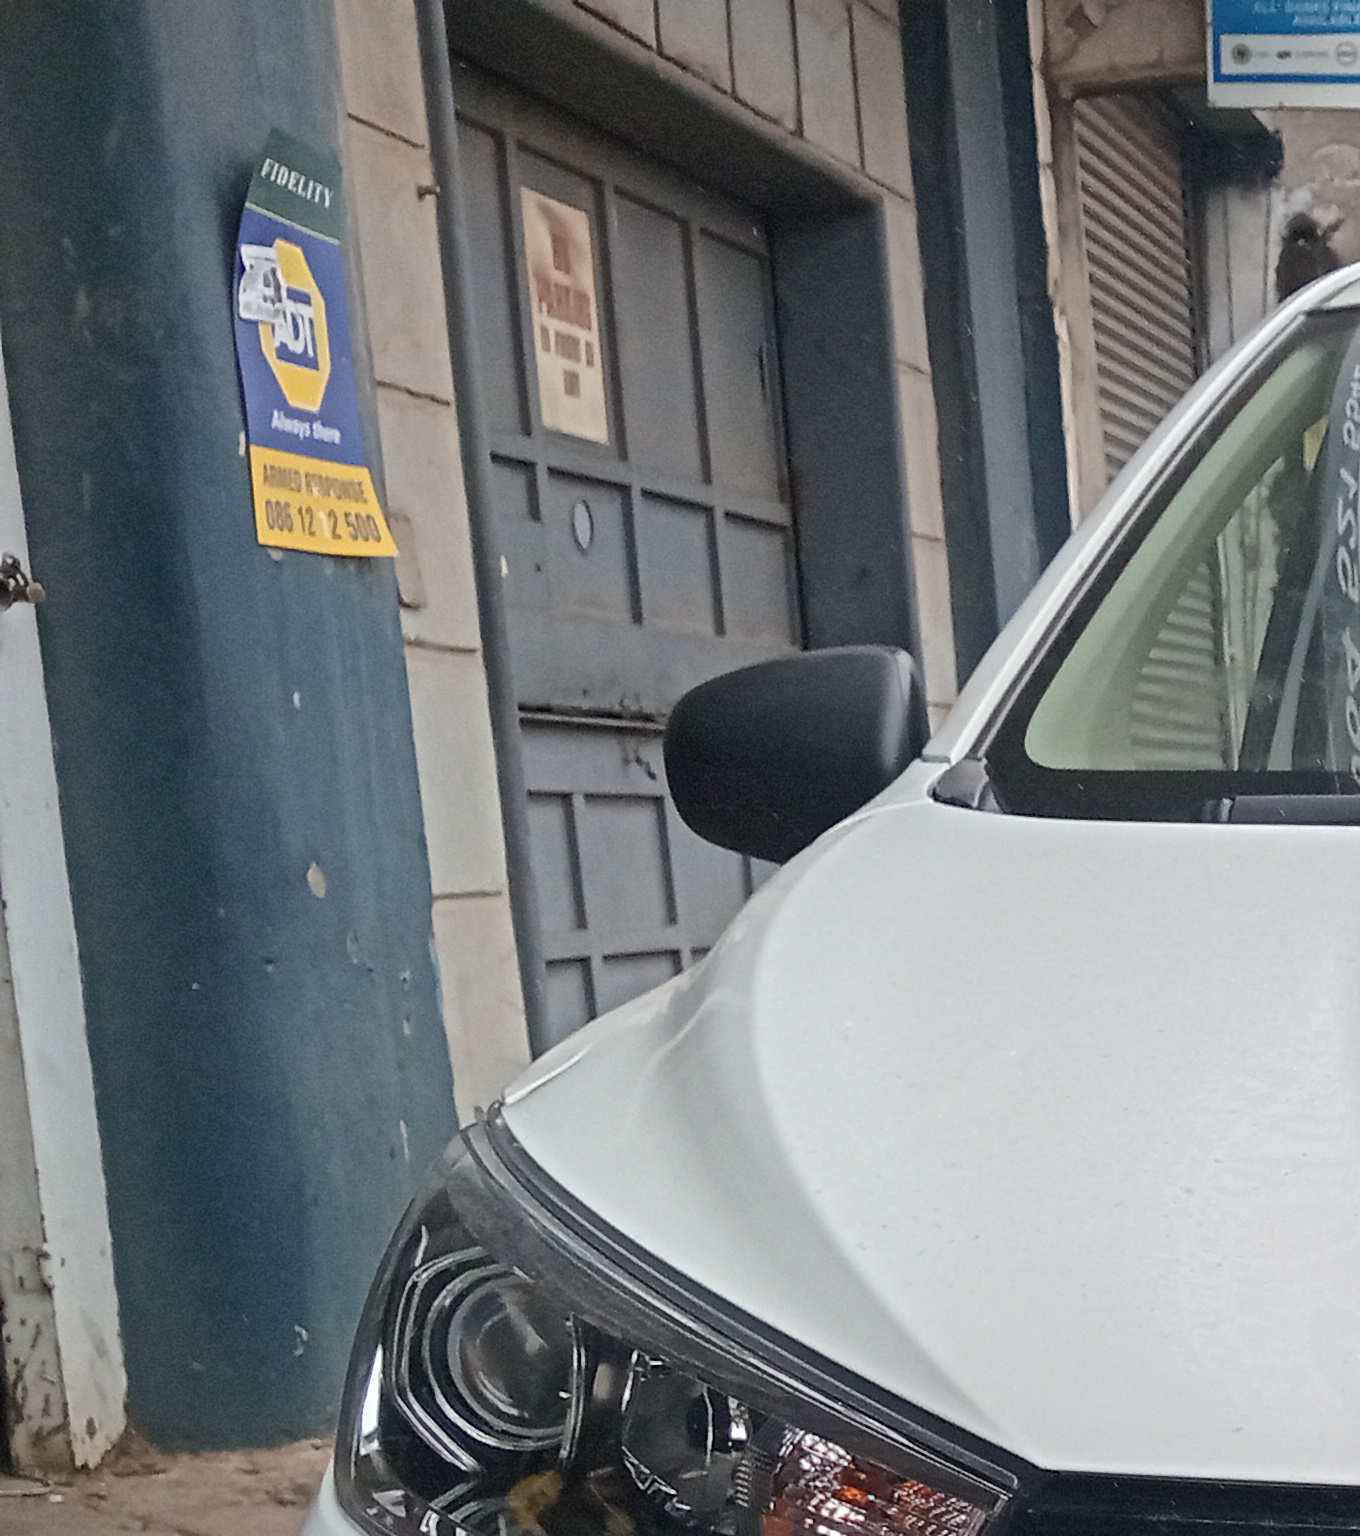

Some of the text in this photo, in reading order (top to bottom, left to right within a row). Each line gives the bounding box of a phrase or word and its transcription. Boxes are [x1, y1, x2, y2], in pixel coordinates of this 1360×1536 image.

[260, 157, 334, 209] FIDELITY
[274, 298, 315, 359] ADT
[265, 500, 294, 533] 086
[297, 506, 316, 538] 12
[344, 510, 382, 543] 500
